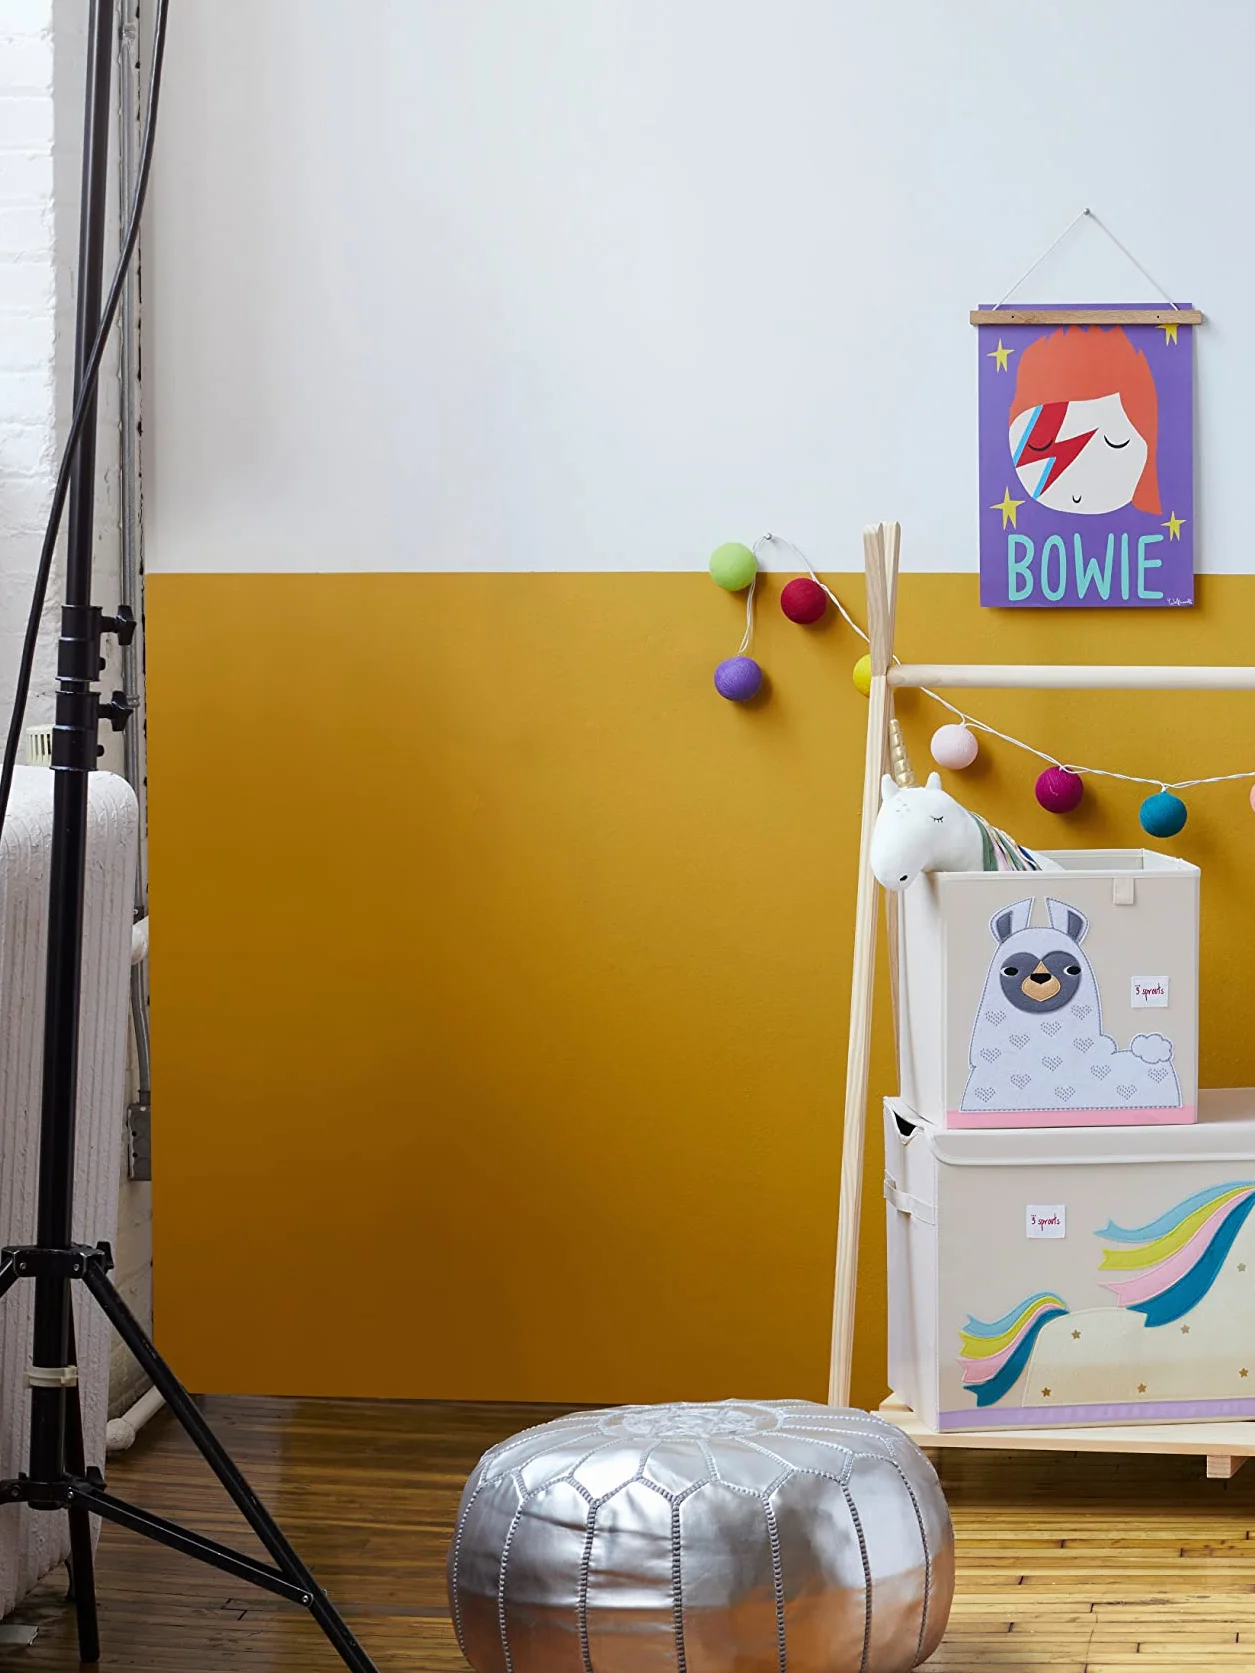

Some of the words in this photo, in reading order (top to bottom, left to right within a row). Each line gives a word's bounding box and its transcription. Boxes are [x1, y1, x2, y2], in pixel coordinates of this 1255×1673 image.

[1007, 533, 1164, 601] BOWIE
[1141, 982, 1165, 1001] sprouts
[1037, 1212, 1061, 1231] sprouts
